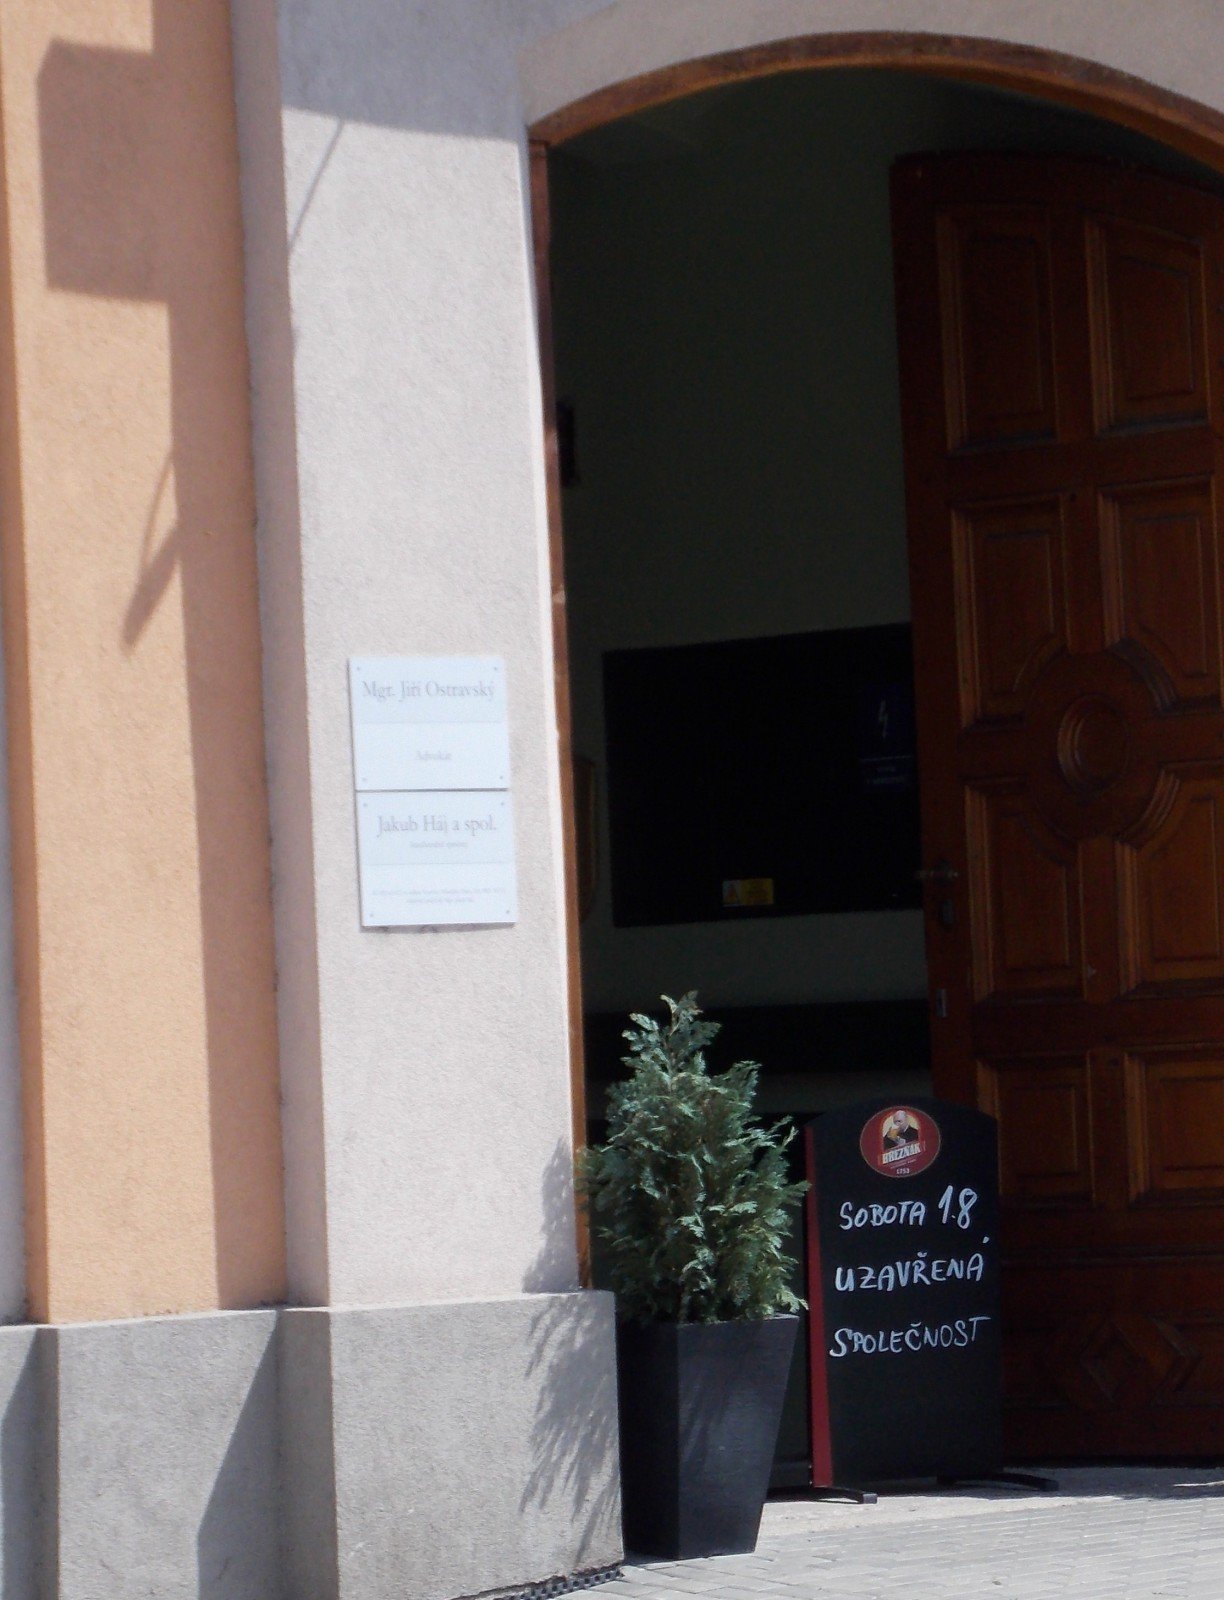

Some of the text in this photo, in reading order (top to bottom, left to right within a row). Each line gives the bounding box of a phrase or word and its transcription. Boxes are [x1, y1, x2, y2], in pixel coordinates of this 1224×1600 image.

[376, 814, 418, 838] Jakub
[452, 820, 460, 831] a
[464, 813, 497, 837] spol.
[839, 1201, 926, 1231] SOBOTA
[829, 1315, 992, 1358] SPOLEČNOST
